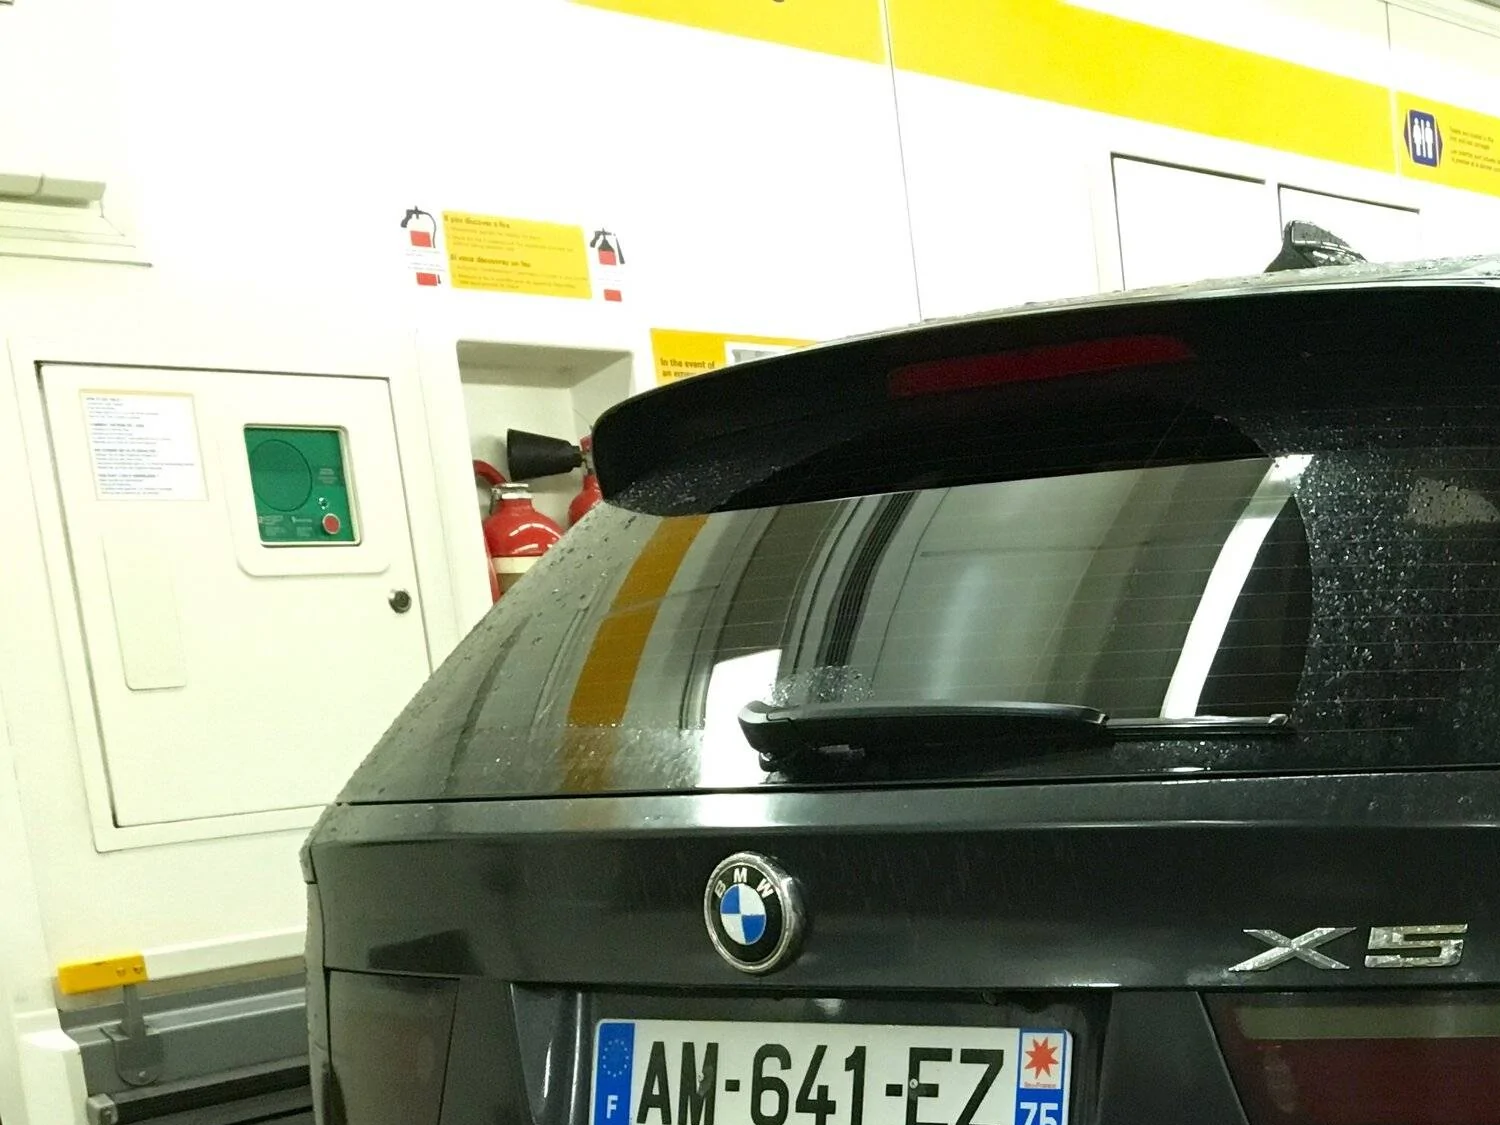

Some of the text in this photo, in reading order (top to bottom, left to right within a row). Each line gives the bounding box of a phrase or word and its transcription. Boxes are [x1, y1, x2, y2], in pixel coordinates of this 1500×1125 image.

[660, 357, 716, 370] In the event of
[714, 867, 775, 899] BMW
[1228, 923, 1469, 972] X5
[606, 1094, 619, 1119] F
